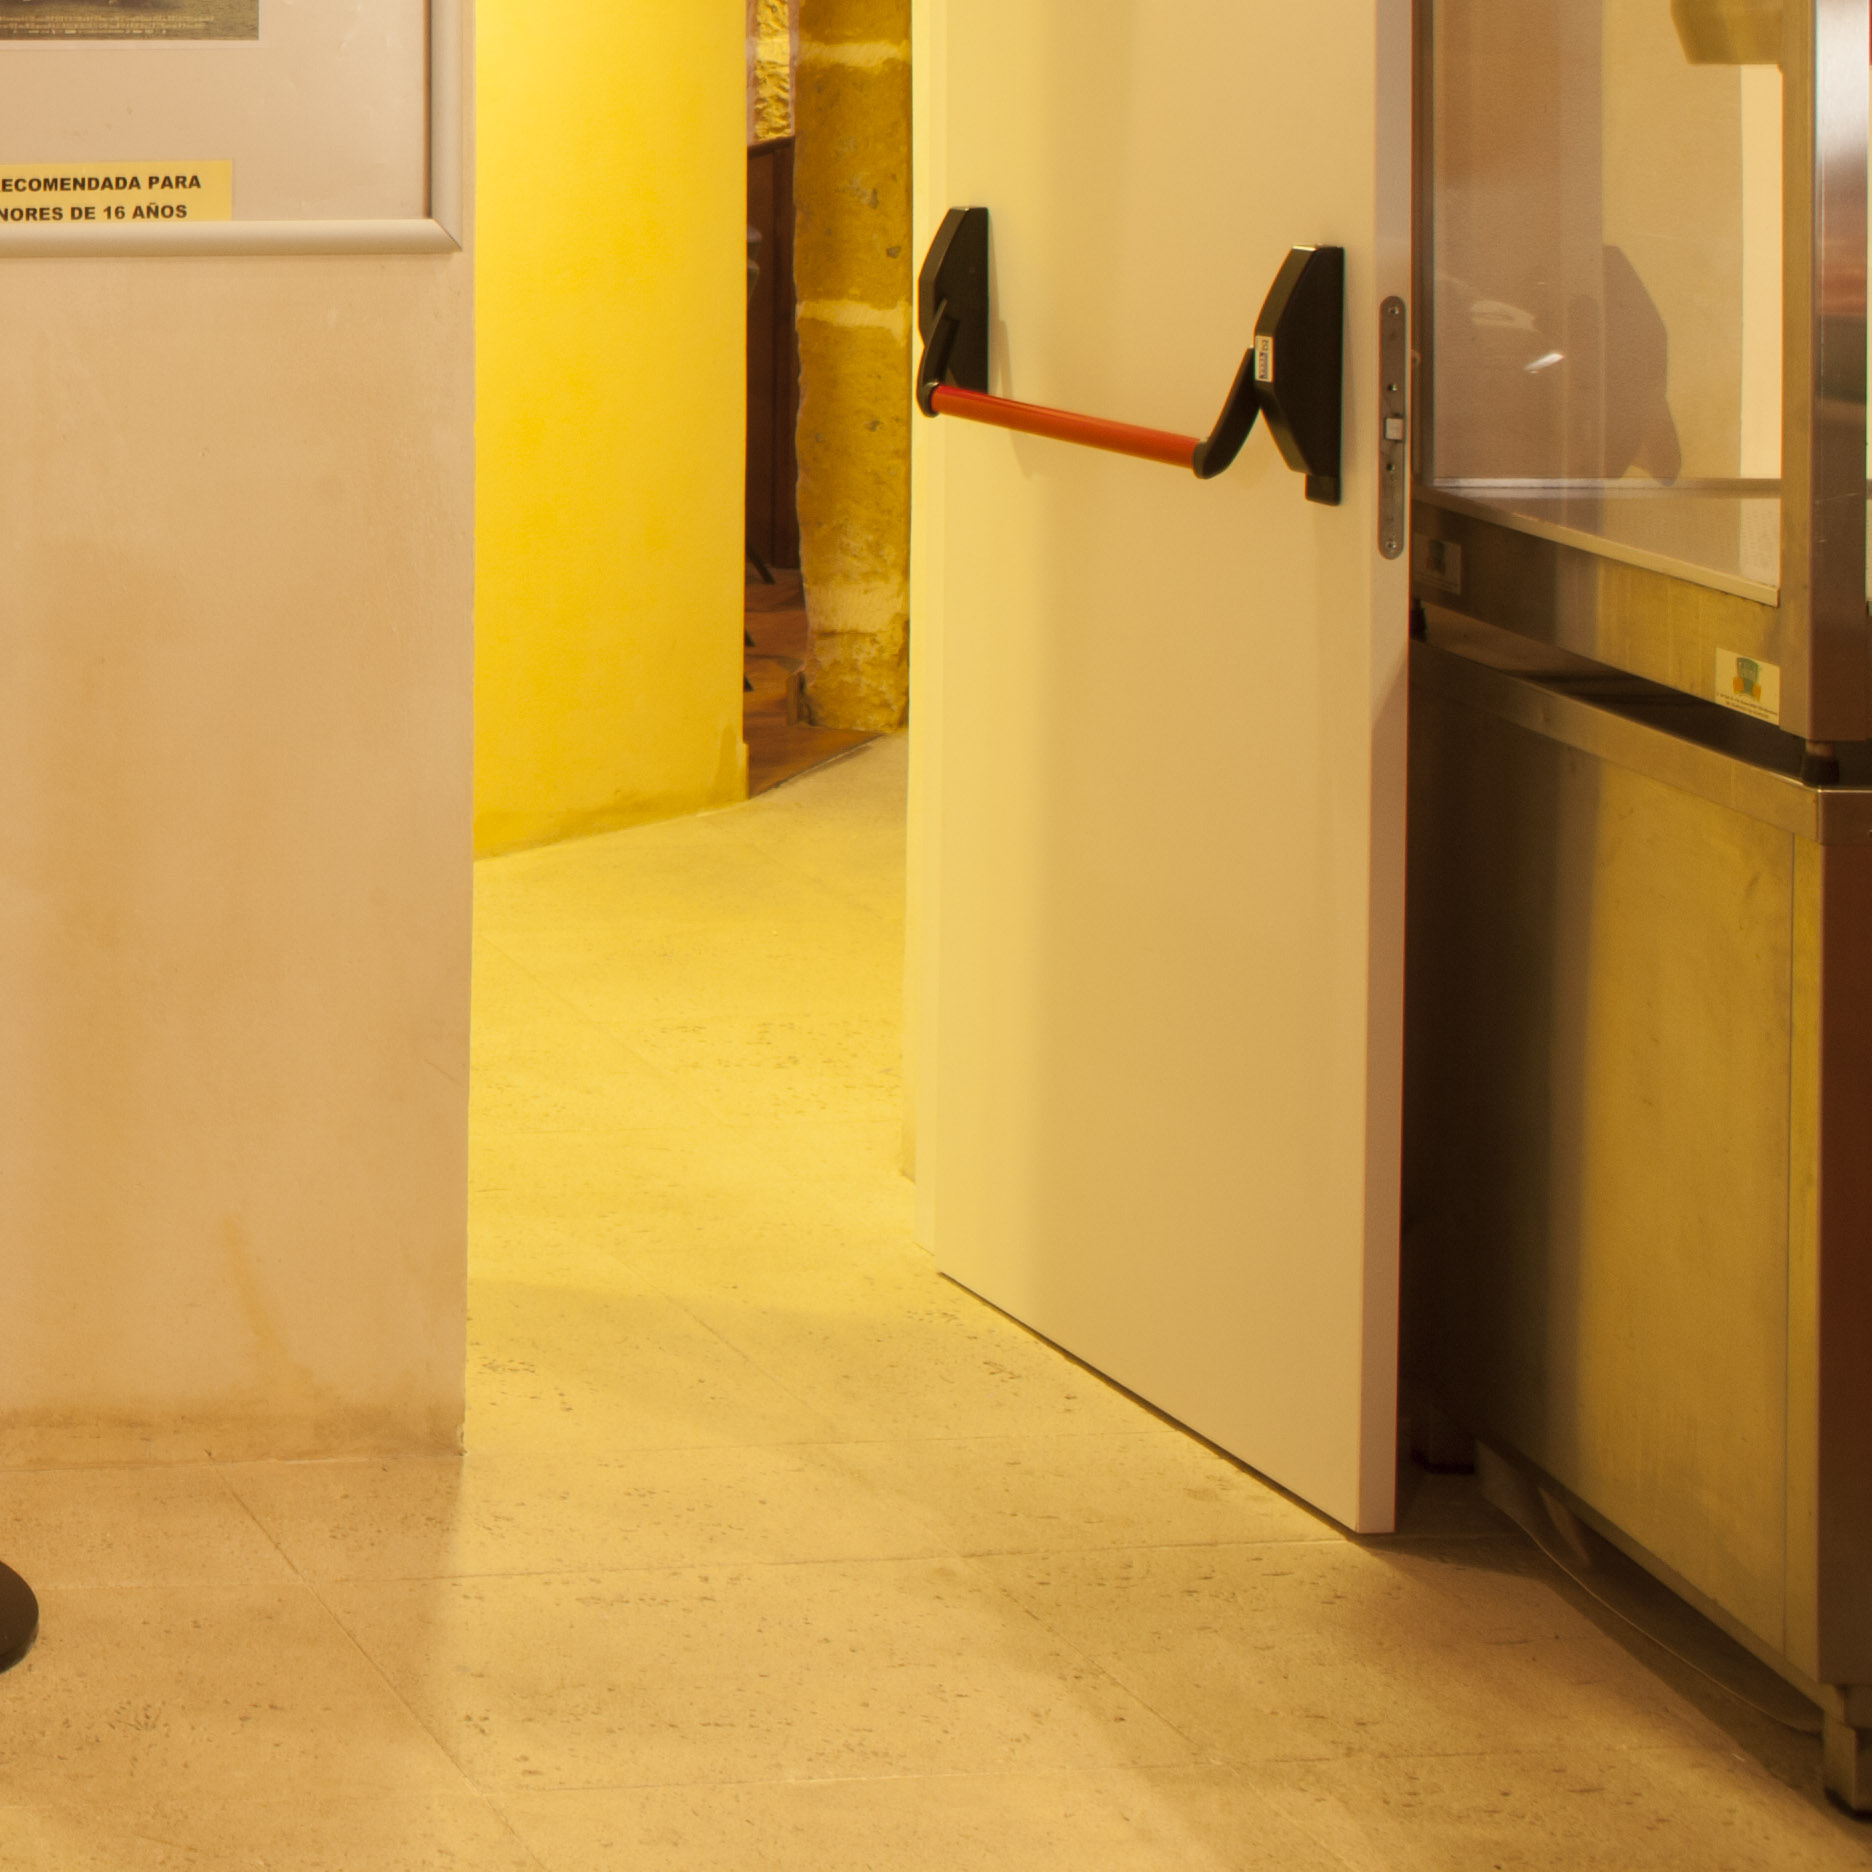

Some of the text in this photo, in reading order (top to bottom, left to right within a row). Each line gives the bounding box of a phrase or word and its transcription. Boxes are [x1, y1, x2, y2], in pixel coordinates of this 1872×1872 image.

[148, 175, 202, 190] PARA
[70, 206, 96, 220] DE
[103, 205, 126, 220] 16
[131, 202, 188, 219] AÑOS
